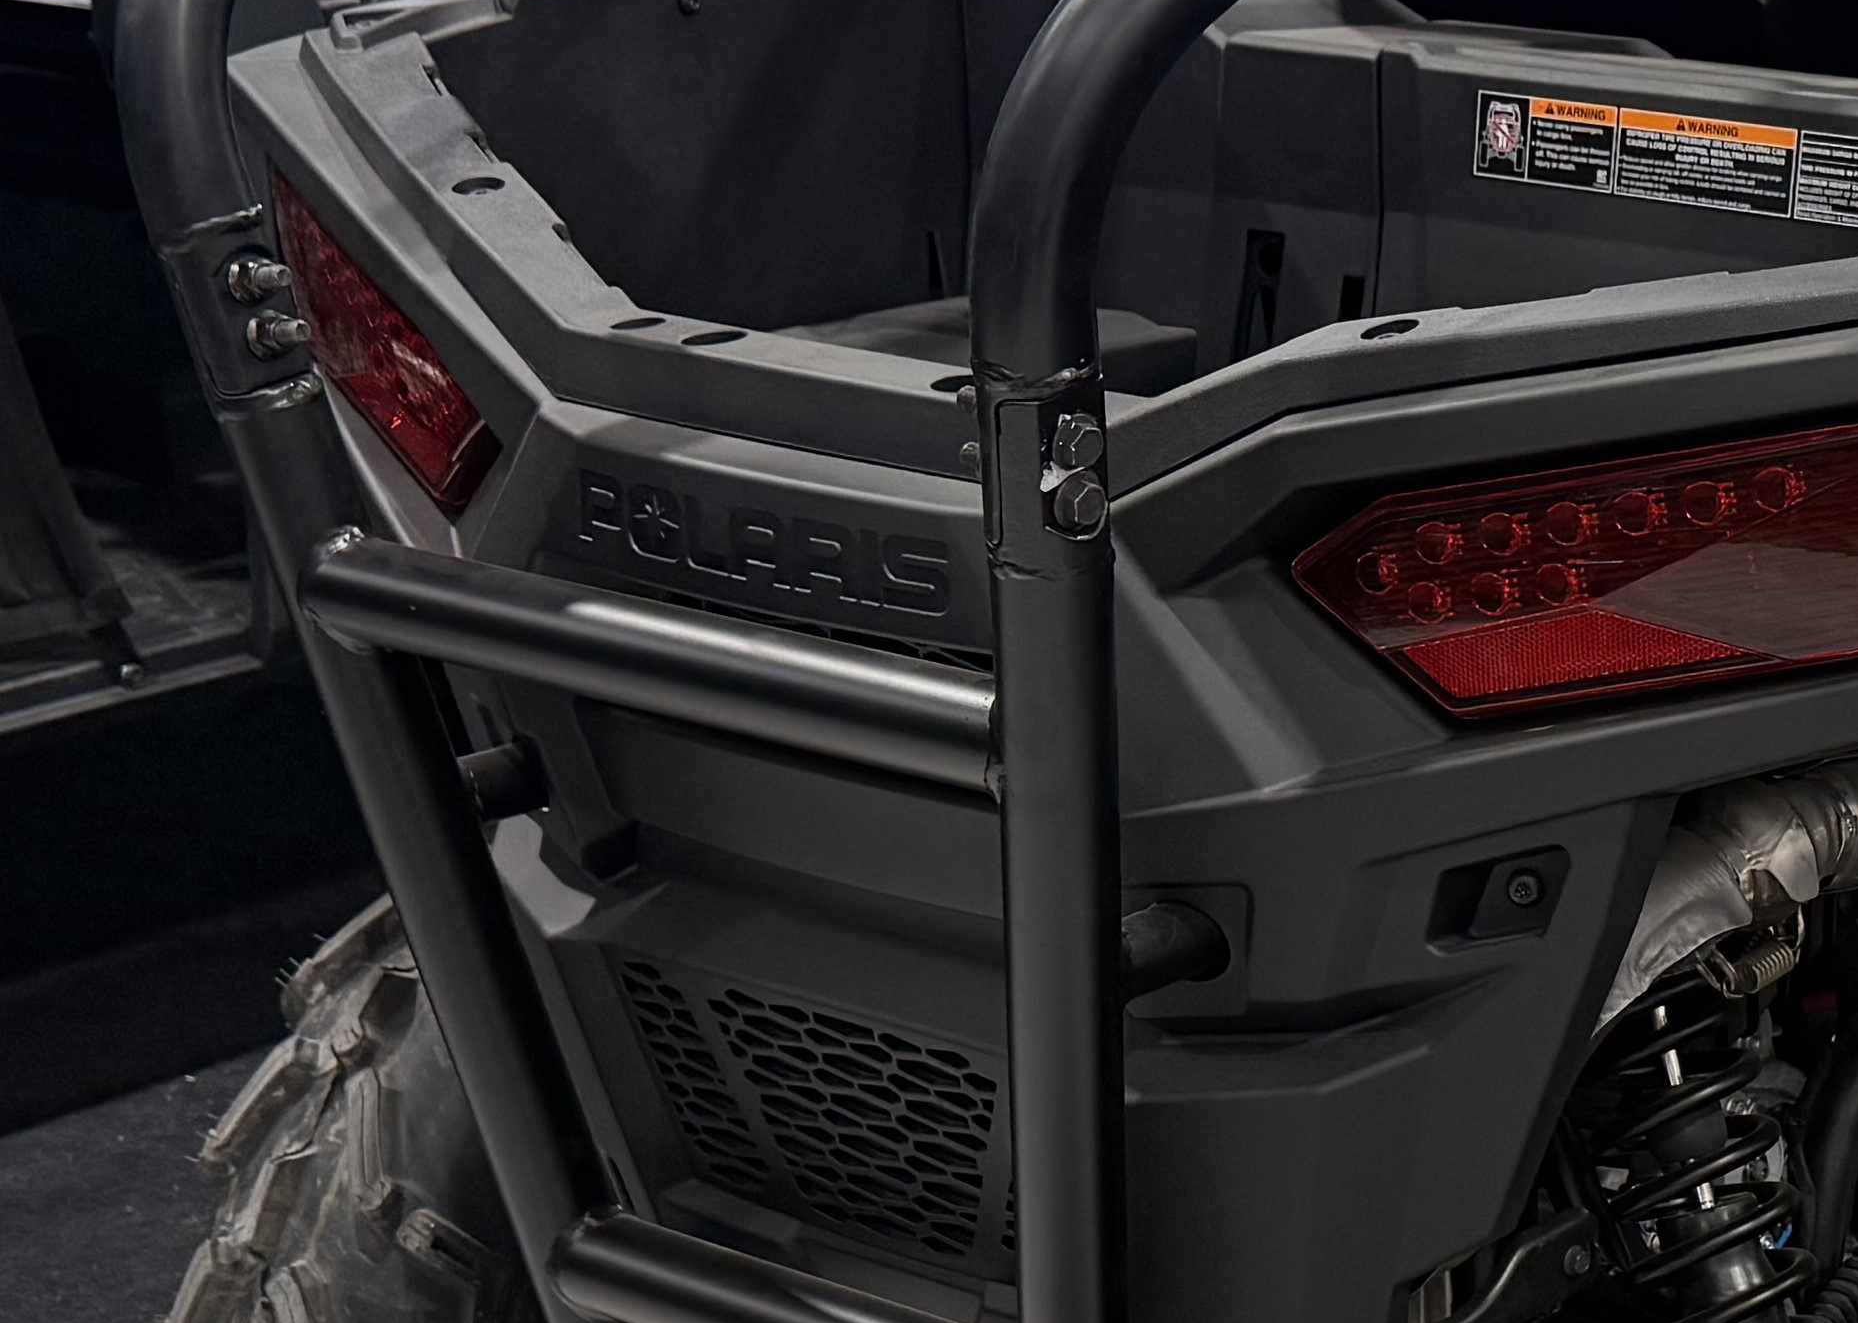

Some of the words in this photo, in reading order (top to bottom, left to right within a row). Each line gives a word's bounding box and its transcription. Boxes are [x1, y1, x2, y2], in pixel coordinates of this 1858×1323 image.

[1556, 104, 1606, 121] WARNING
[1687, 120, 1739, 138] WARNING
[578, 468, 950, 618] POLARIS
